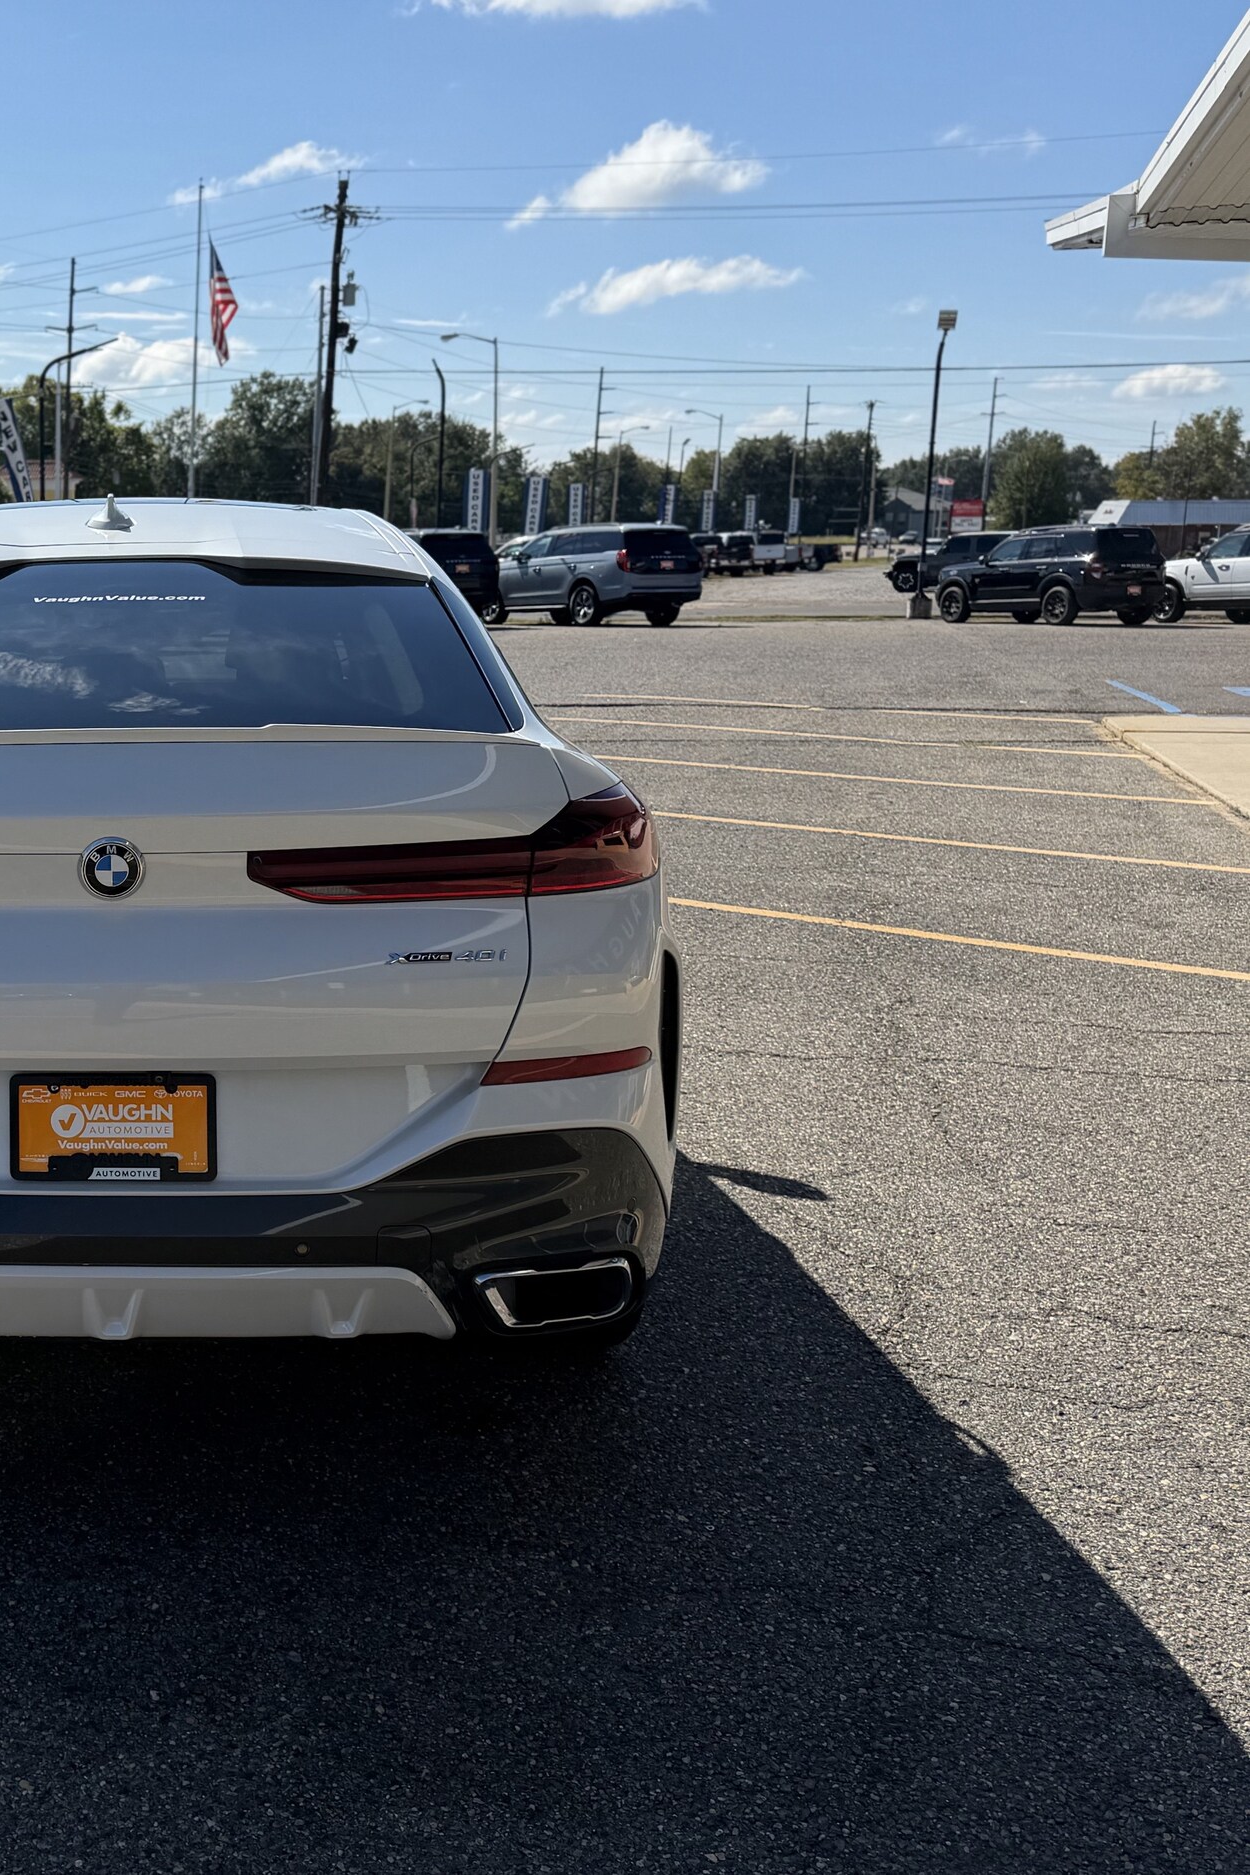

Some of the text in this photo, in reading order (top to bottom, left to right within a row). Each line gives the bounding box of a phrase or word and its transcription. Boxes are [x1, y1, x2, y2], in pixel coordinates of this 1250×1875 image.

[470, 473, 480, 531] USED CARS
[33, 595, 206, 603] VaughnValue.com
[90, 845, 135, 863] BMW
[115, 1090, 146, 1098] GMC
[81, 1103, 173, 1121] VAUGHN
[89, 1126, 170, 1135] AUTOMOTIVE
[58, 1139, 168, 1152] VaughnValue.com
[95, 1170, 158, 1178] AUTOMOTIVE
